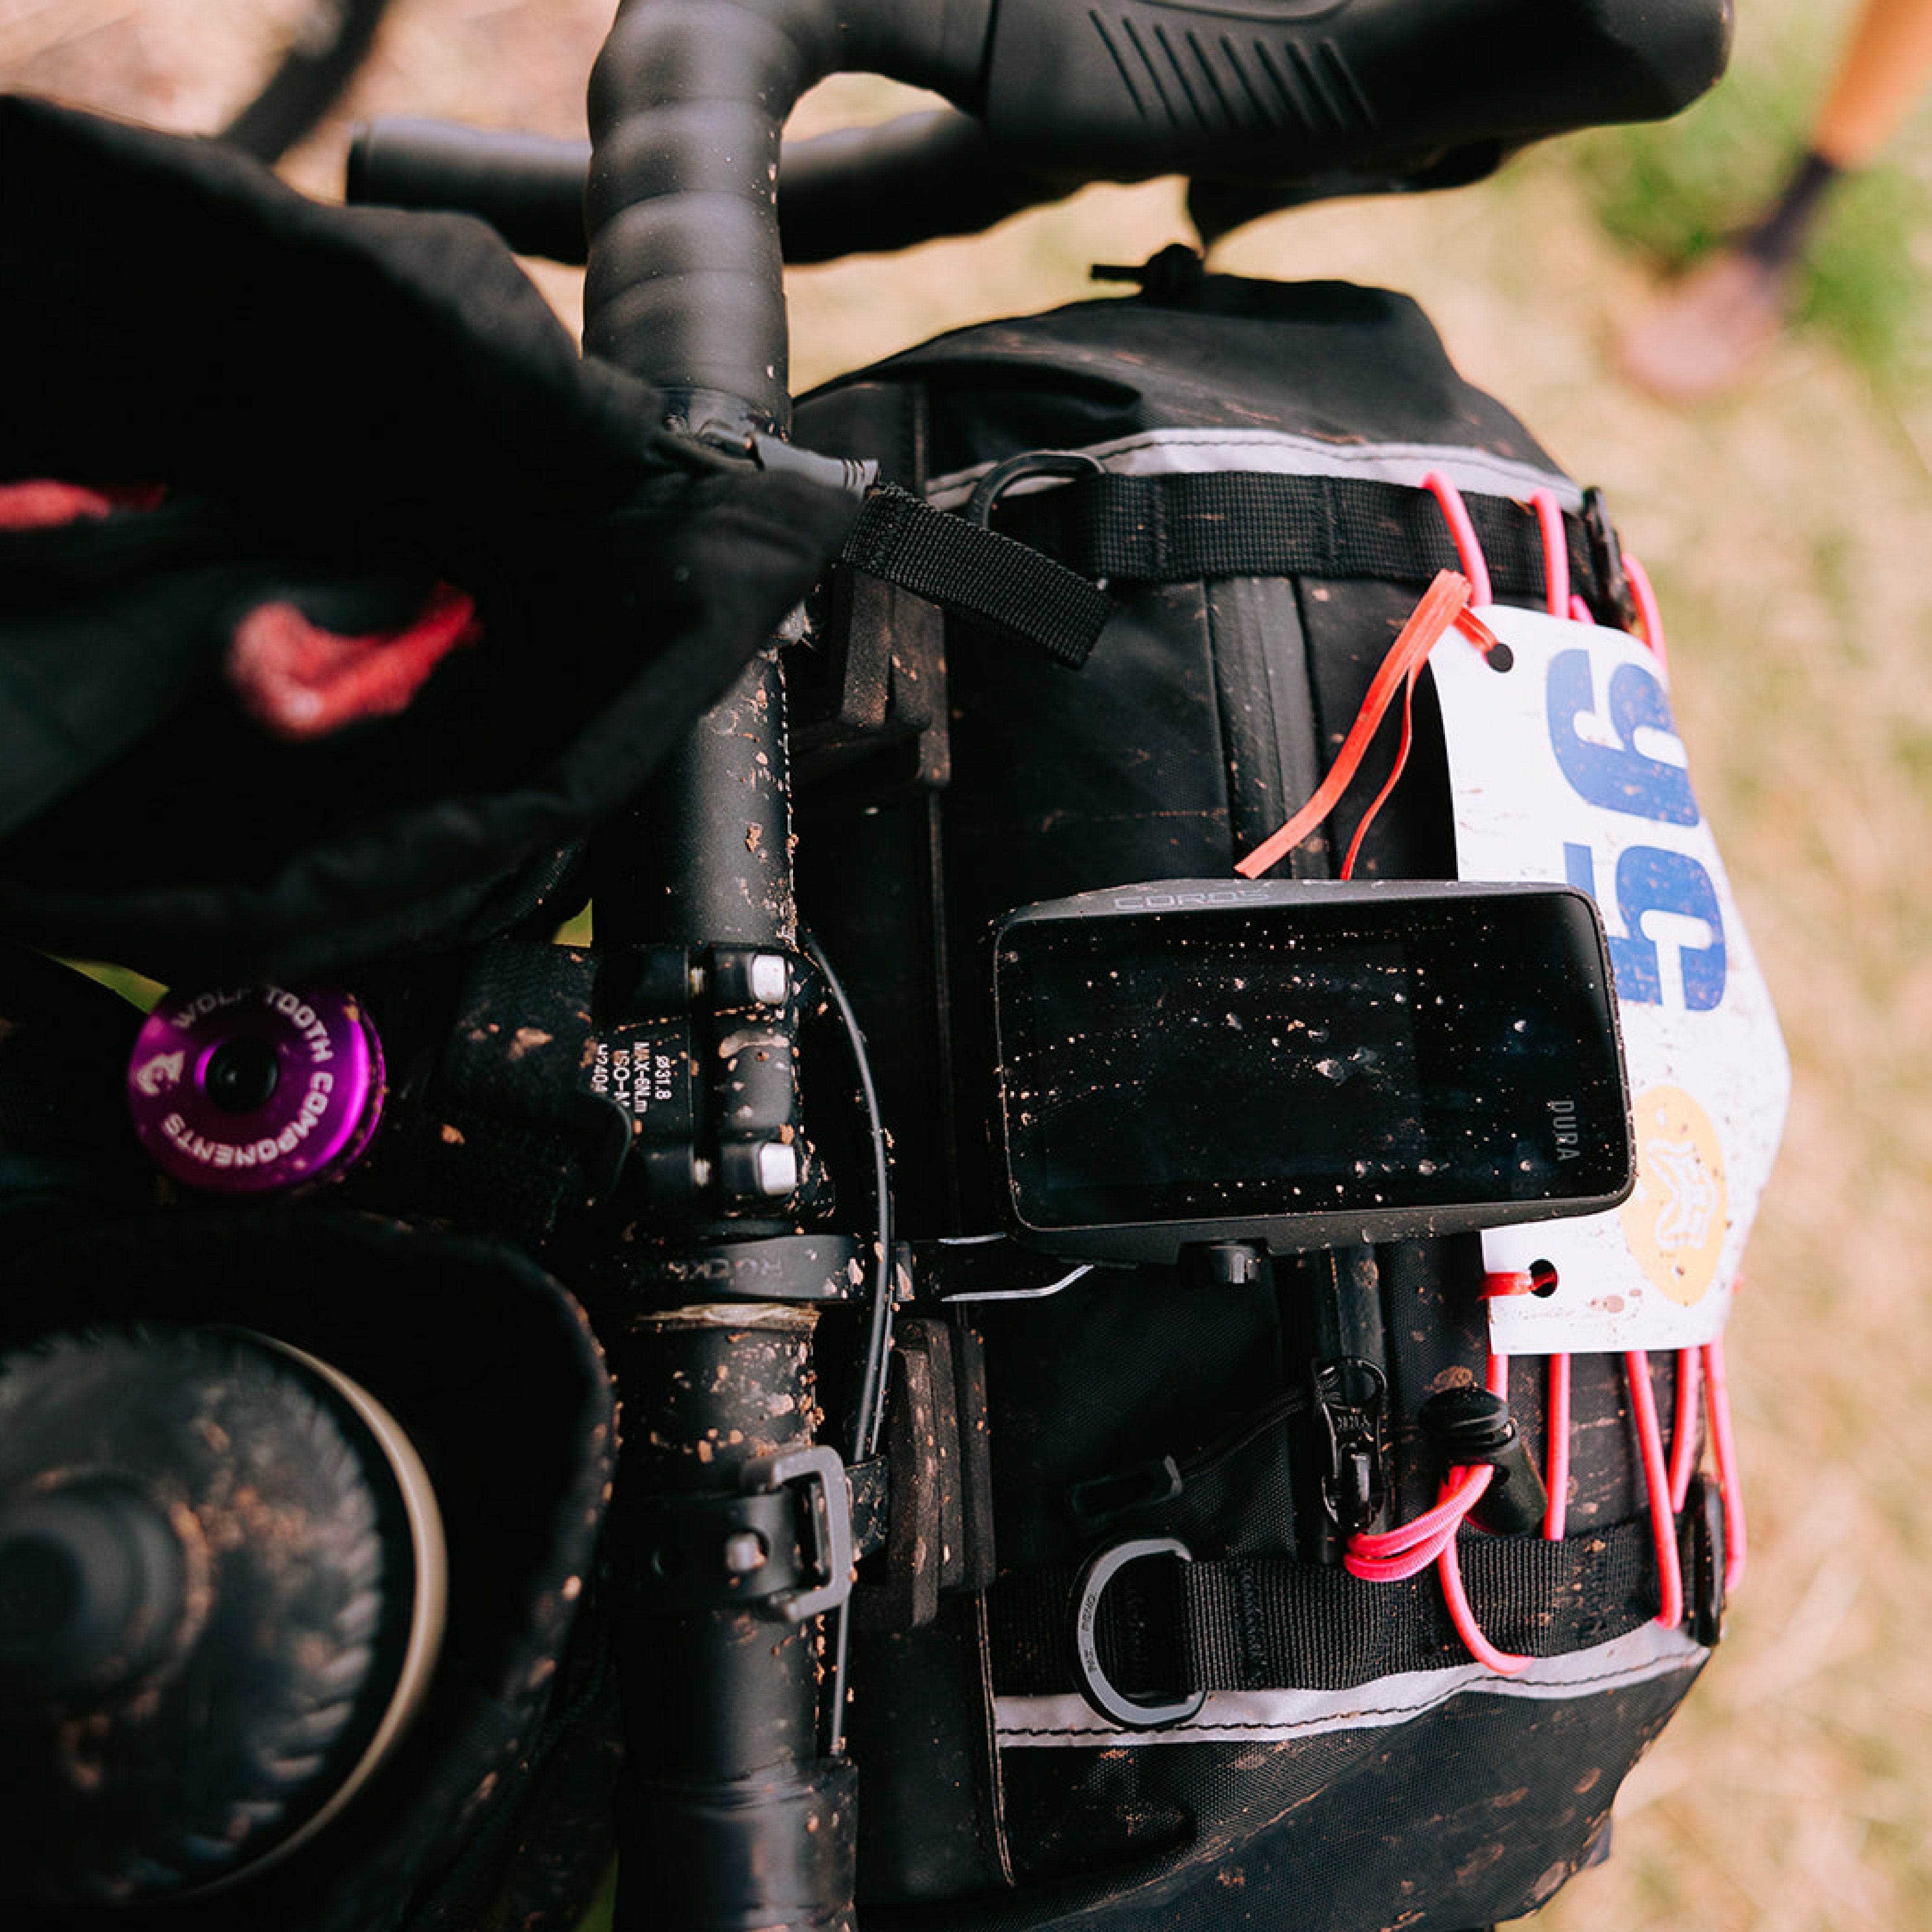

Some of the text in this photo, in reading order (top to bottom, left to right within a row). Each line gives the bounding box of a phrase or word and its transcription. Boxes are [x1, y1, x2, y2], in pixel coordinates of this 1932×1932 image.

[1114, 891, 1269, 911] COROS
[163, 984, 334, 1168] WOLF TOOTH COMPONENTS
[1549, 1100, 1580, 1161] DURA
